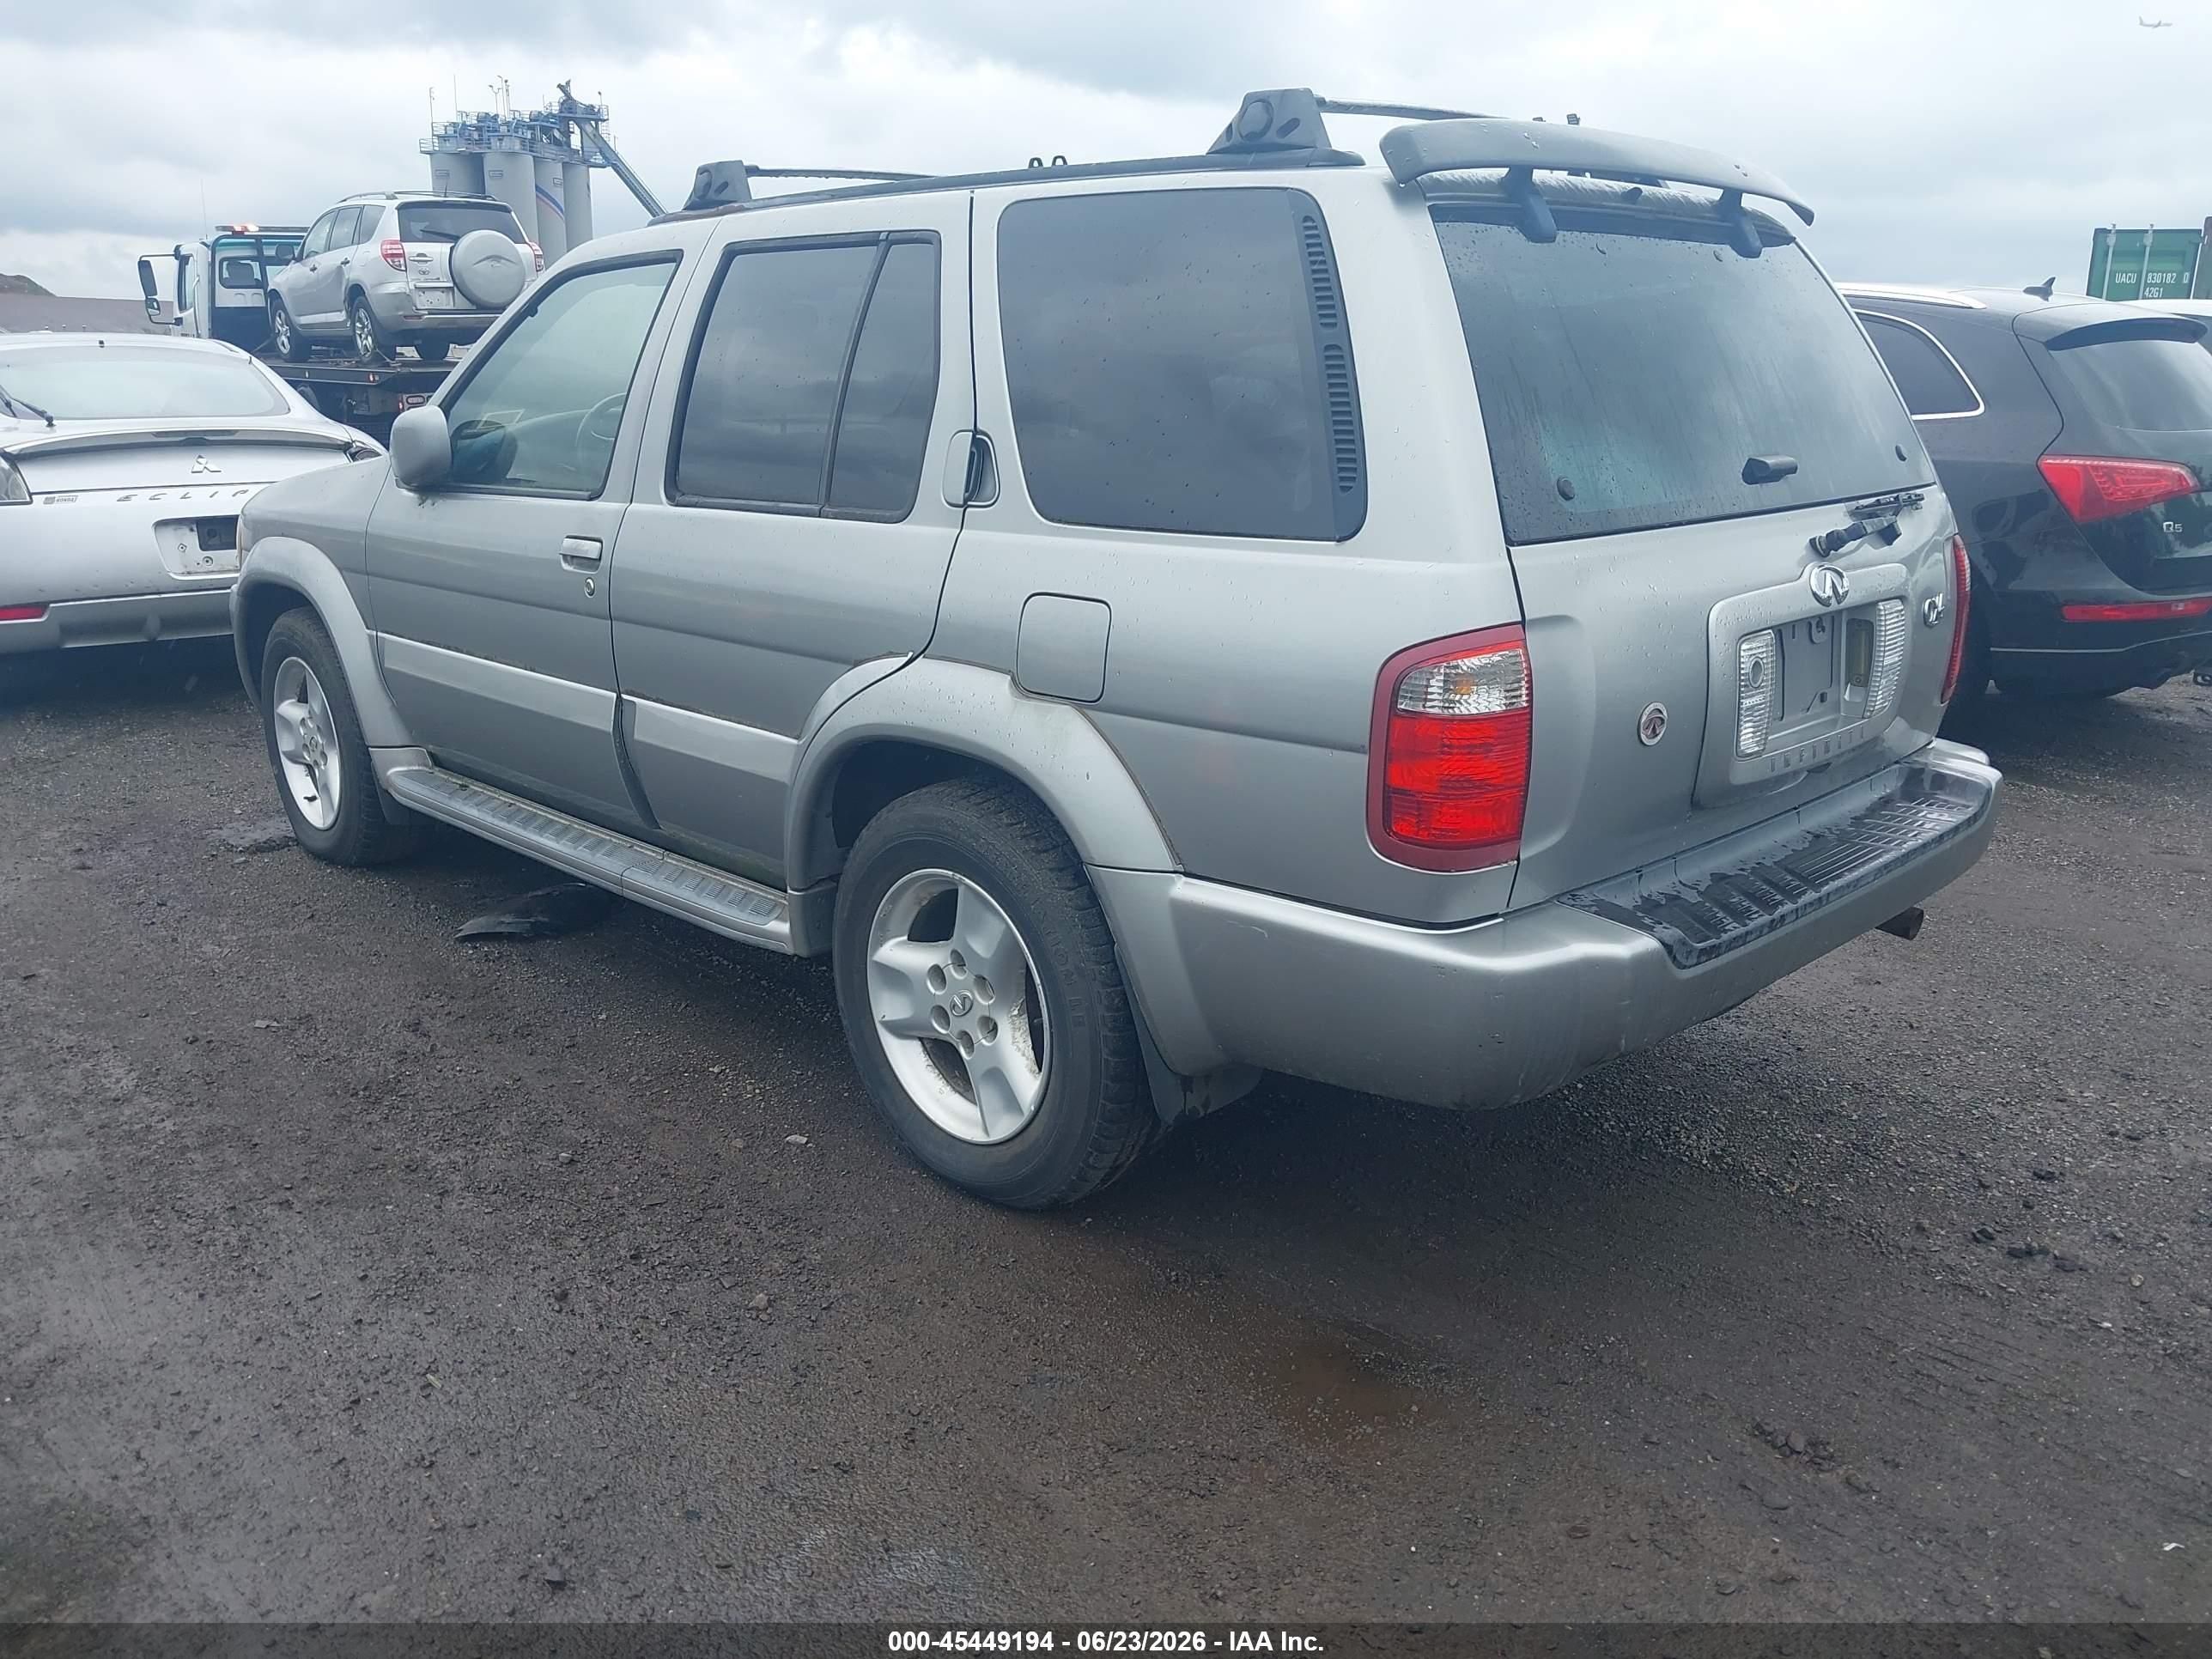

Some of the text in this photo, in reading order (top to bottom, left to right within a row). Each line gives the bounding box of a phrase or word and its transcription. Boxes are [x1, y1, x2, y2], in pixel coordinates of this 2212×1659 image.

[2115, 272, 2137, 284] UACU
[2147, 272, 2176, 284] 830182
[2144, 287, 2164, 299] 42G1
[116, 489, 249, 502] ECLIP
[2162, 521, 2184, 533] Q5
